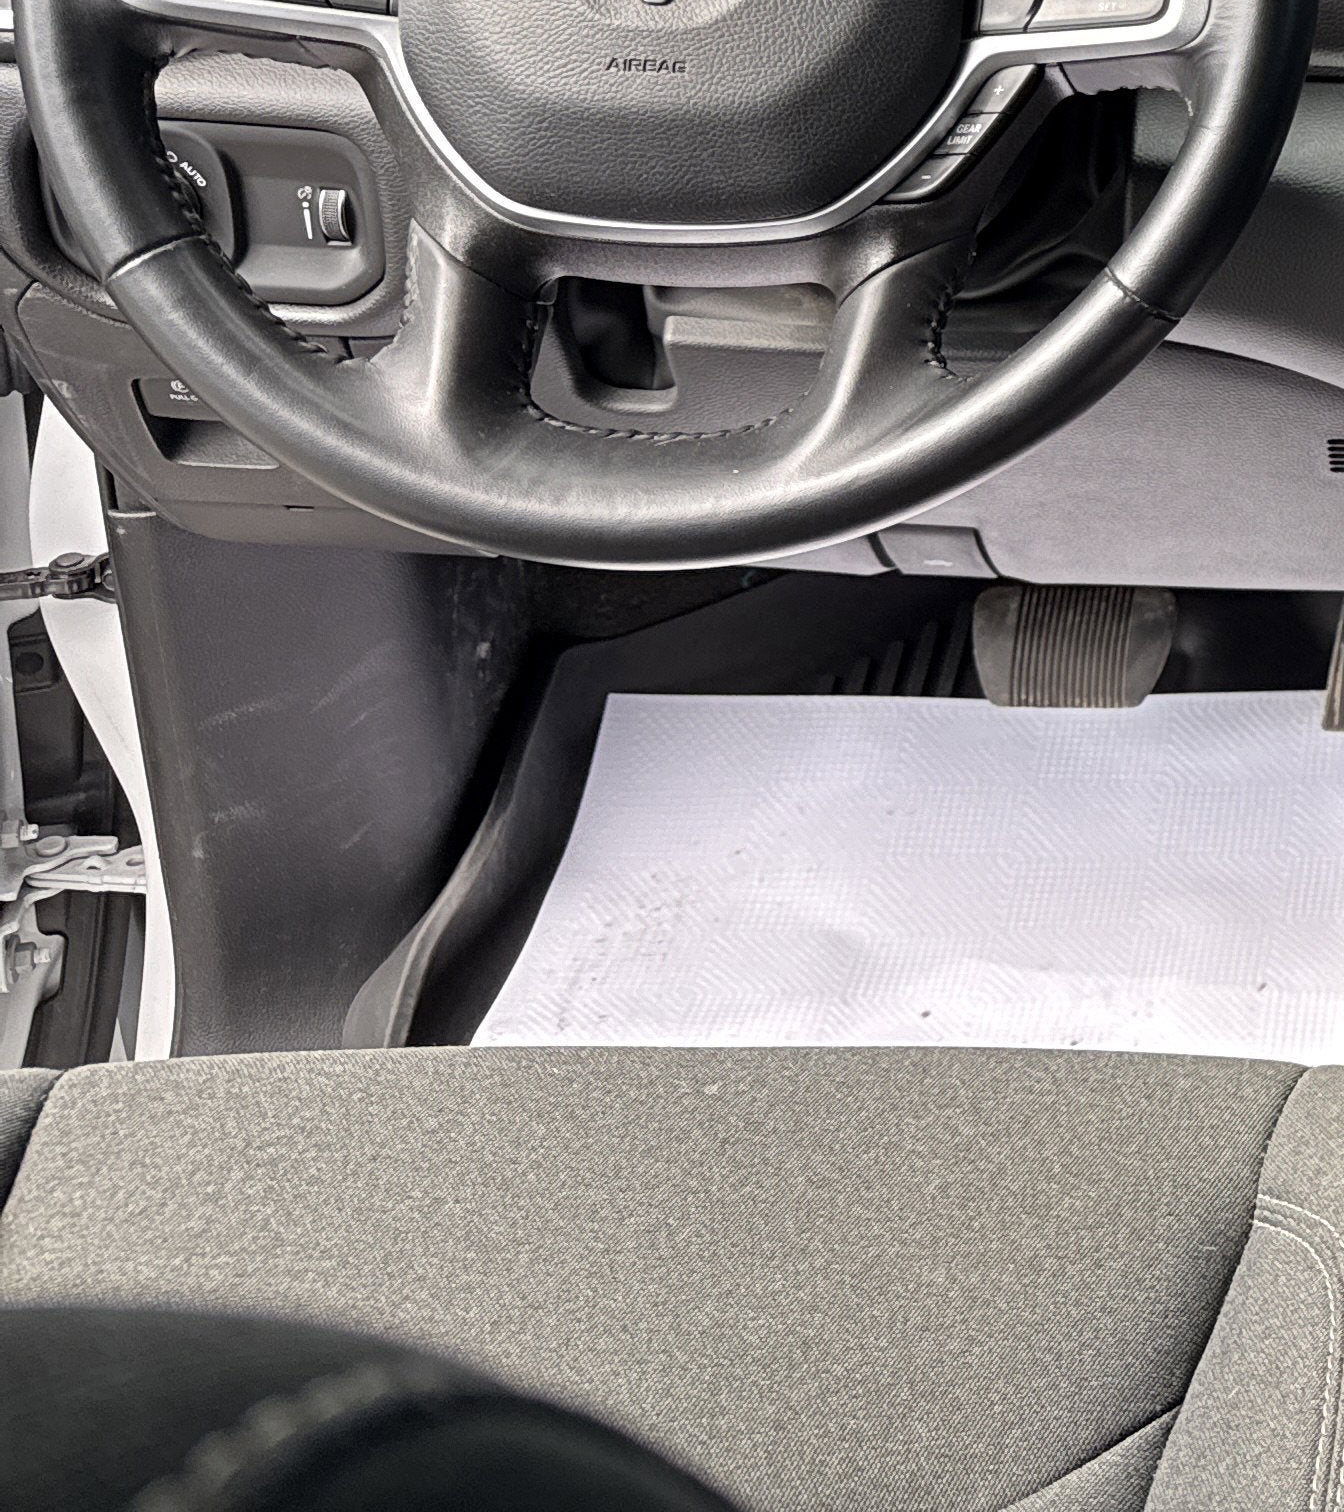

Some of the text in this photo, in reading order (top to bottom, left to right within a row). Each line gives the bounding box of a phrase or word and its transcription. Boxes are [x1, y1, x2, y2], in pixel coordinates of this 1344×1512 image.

[956, 123, 982, 134] GEAR
[946, 134, 973, 145] LIMIT
[179, 160, 207, 187] AUTO
